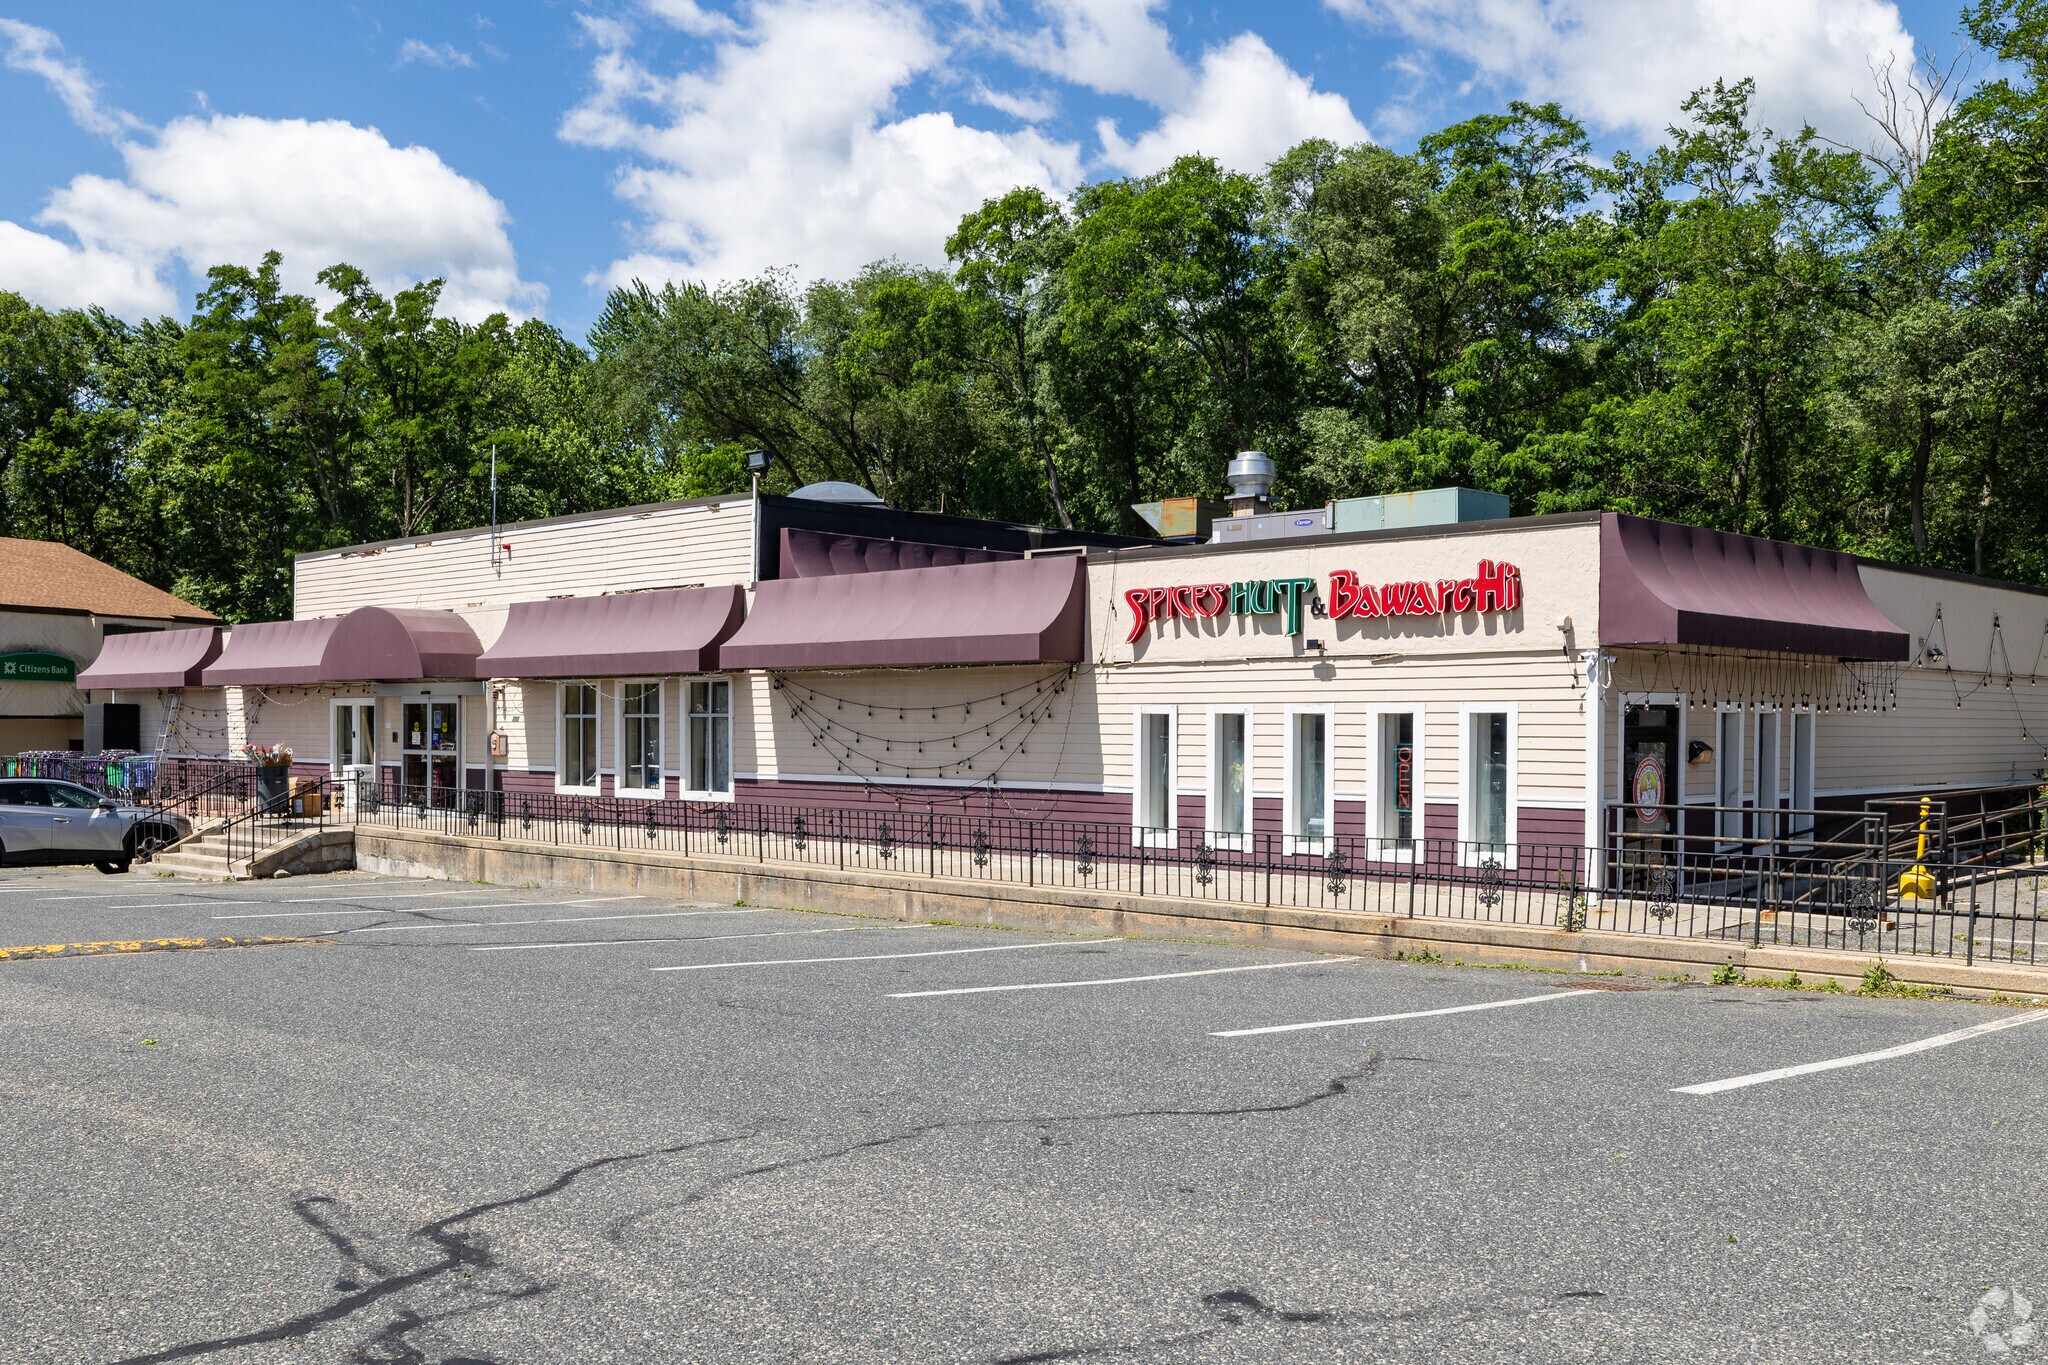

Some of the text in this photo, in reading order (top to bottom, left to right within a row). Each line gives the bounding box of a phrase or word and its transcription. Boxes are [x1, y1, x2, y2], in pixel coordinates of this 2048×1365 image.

[1311, 596, 1327, 615] &
[19, 664, 68, 674] Citizens Bank
[1398, 747, 1411, 809] OPEN
